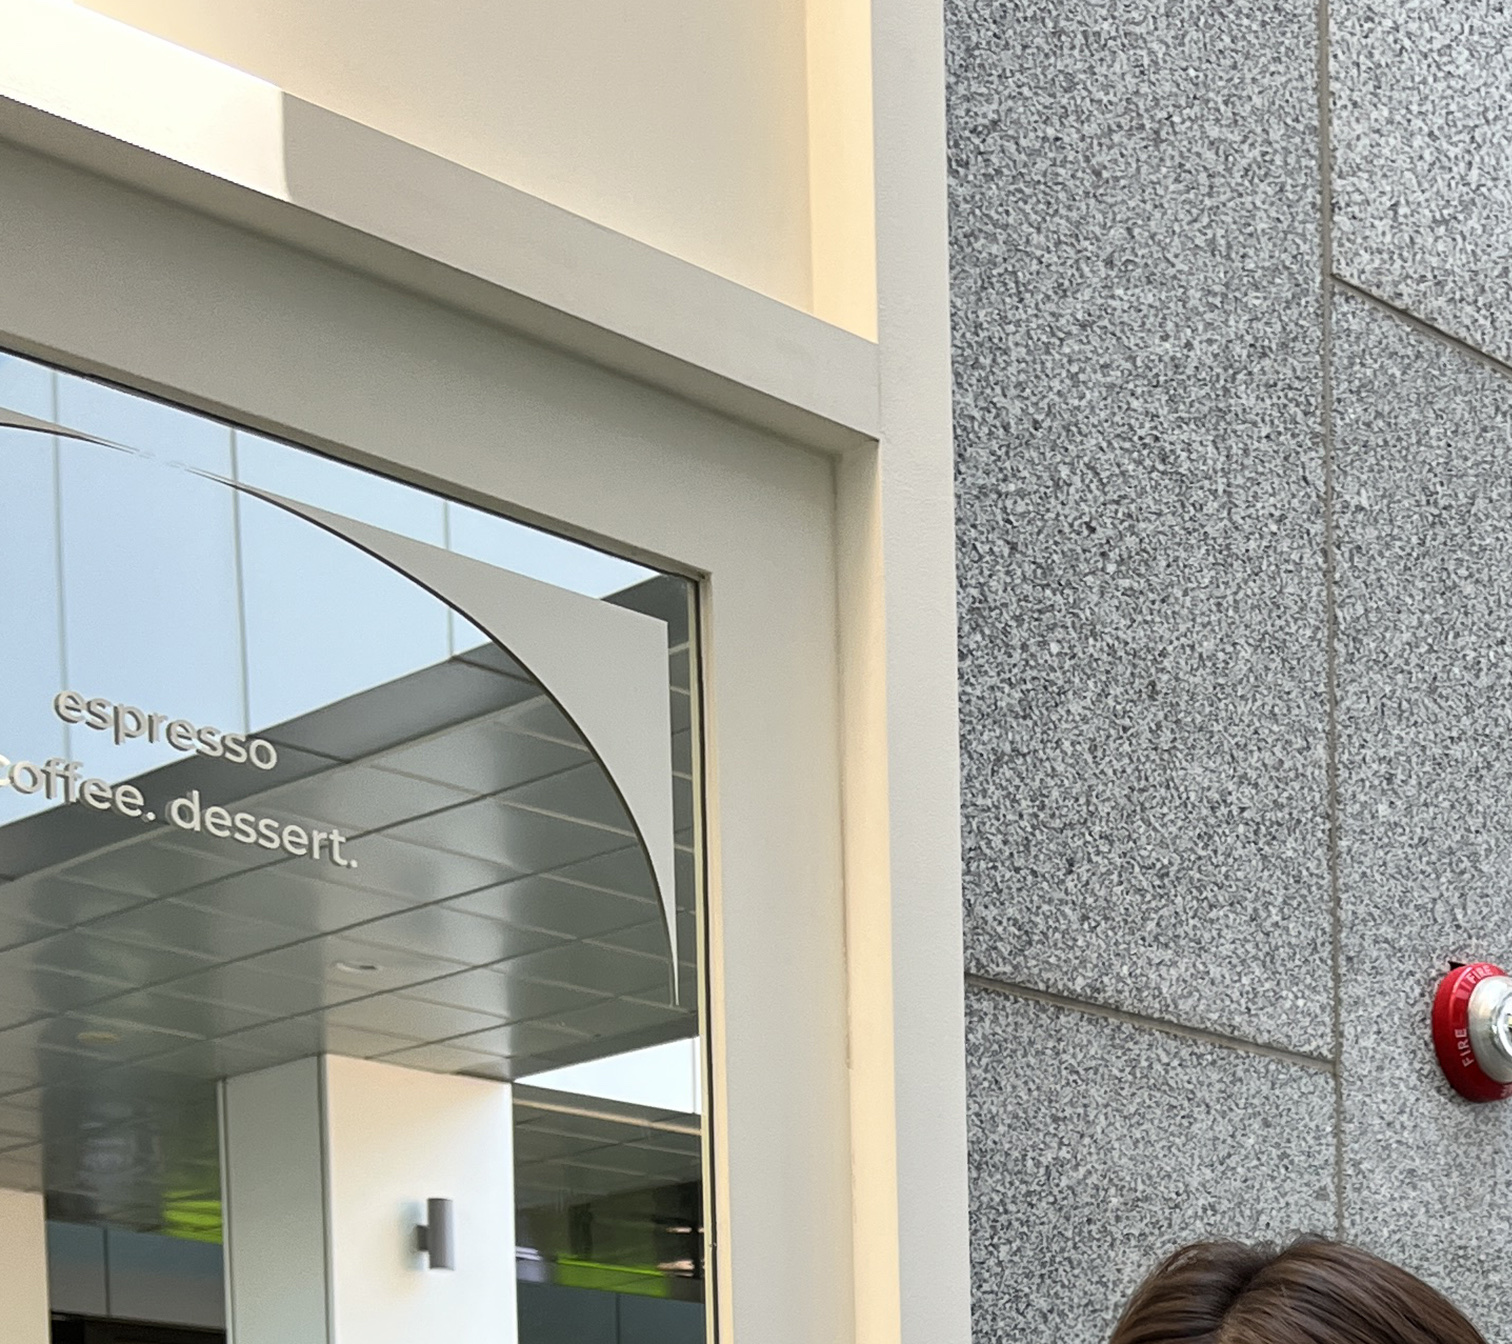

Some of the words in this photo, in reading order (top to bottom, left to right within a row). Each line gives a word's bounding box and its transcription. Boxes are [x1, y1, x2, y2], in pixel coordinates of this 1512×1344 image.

[54, 690, 279, 771] espresso
[167, 789, 359, 869] dessert.
[1466, 965, 1493, 984] FIRE
[1455, 1028, 1474, 1067] FIRE
